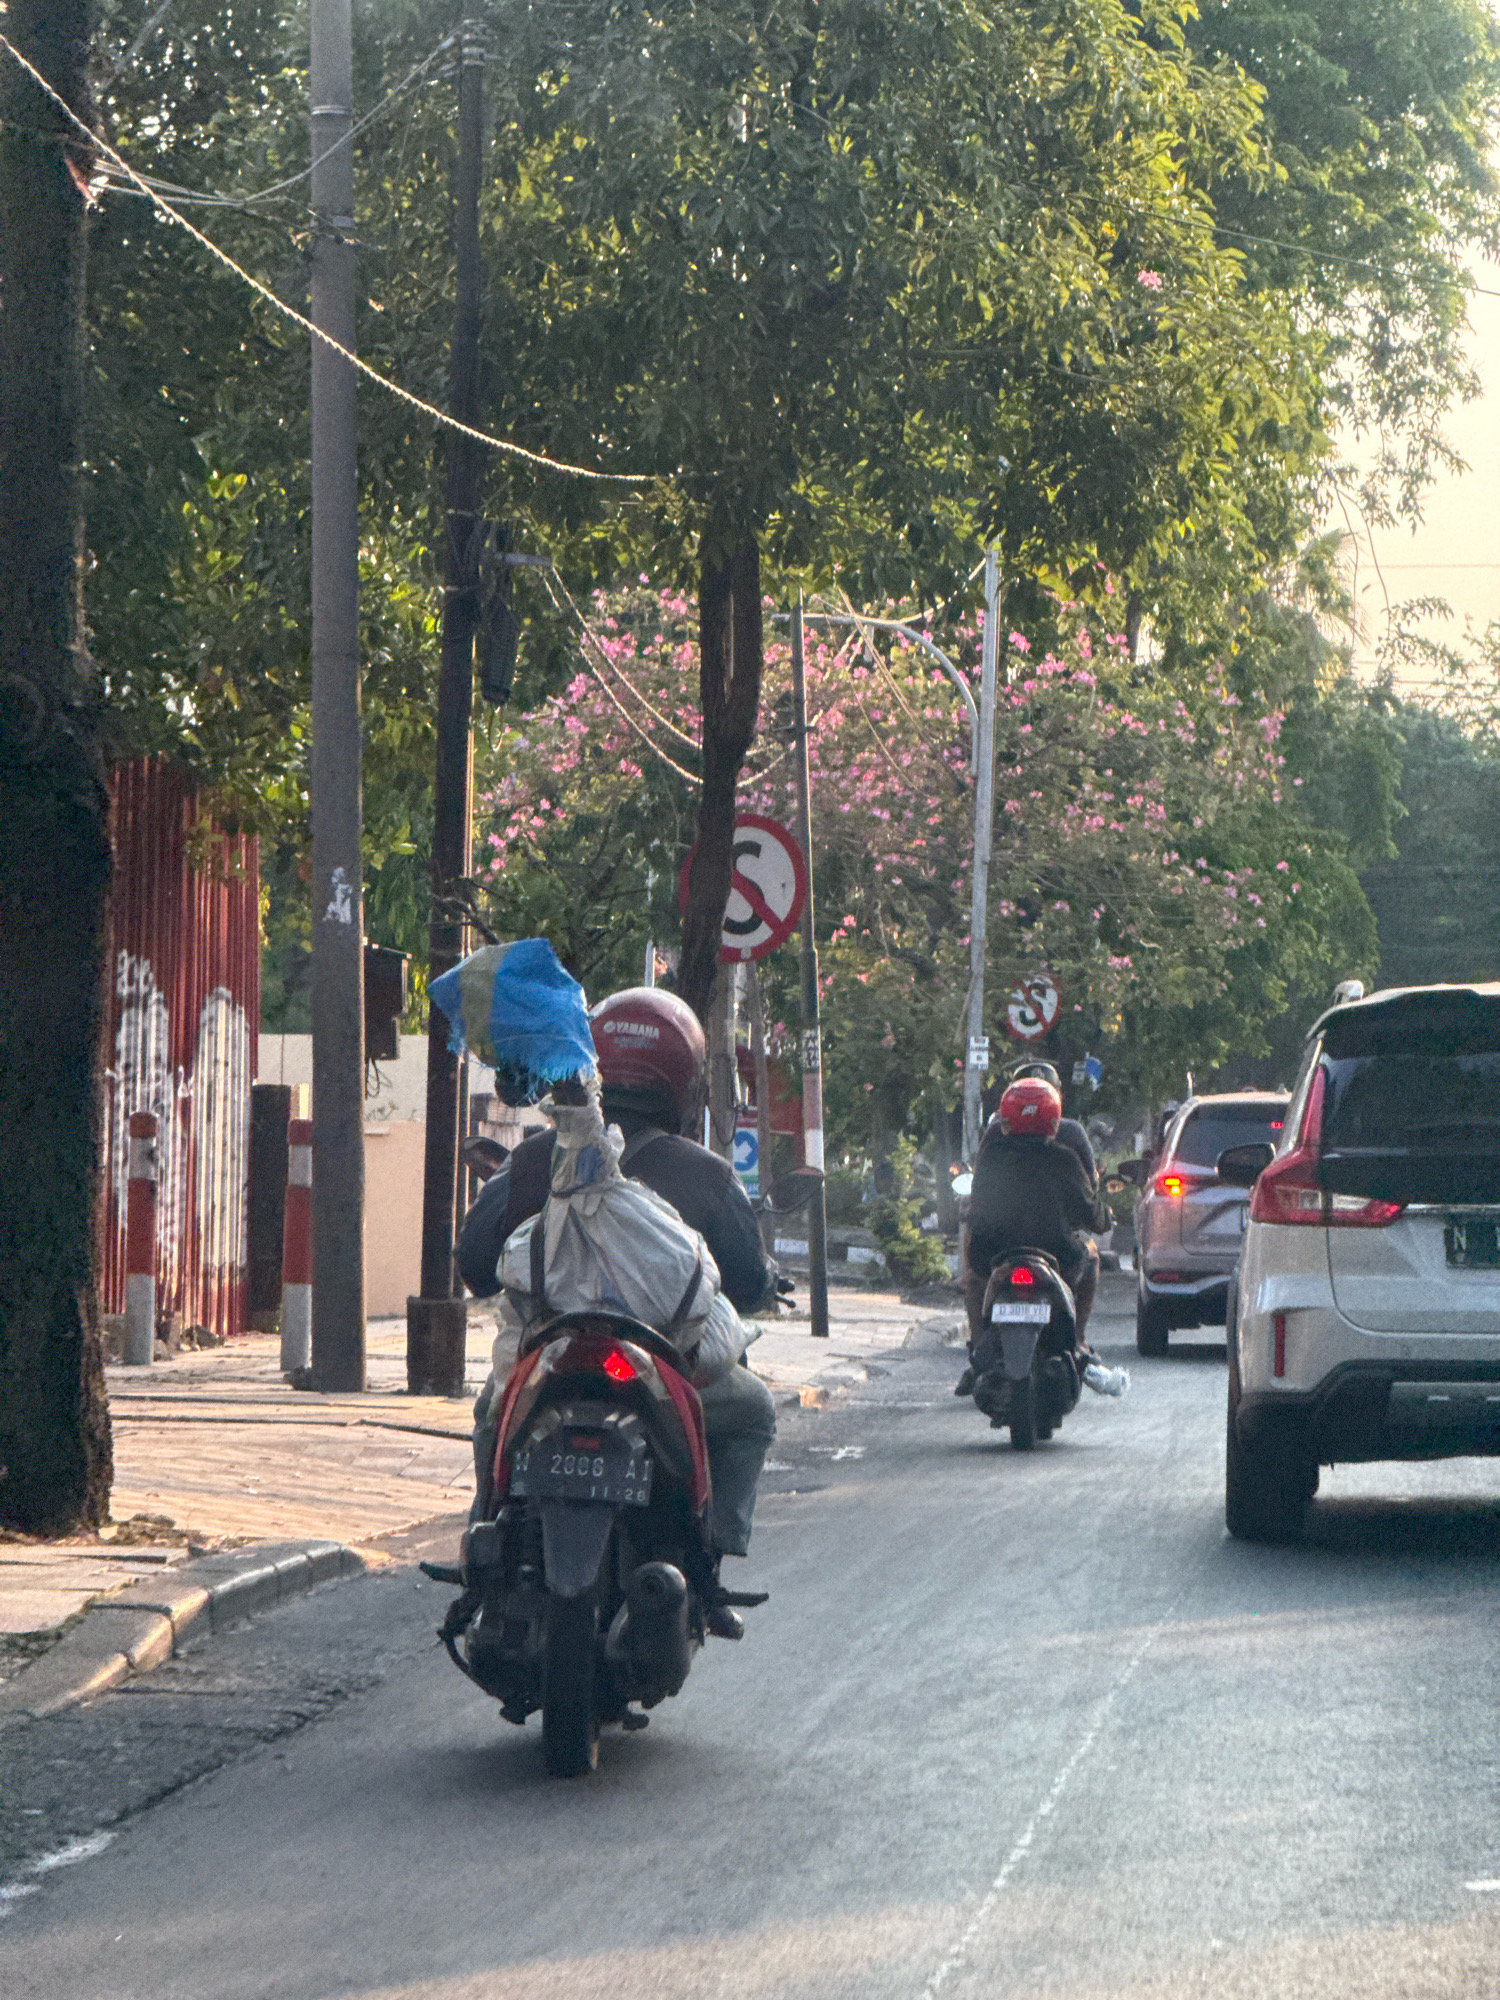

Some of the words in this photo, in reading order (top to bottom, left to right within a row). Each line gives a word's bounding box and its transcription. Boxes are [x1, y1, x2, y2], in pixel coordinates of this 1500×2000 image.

[616, 1021, 660, 1040] YAMAHA
[1453, 1225, 1467, 1250] N
[514, 1451, 530, 1472] W
